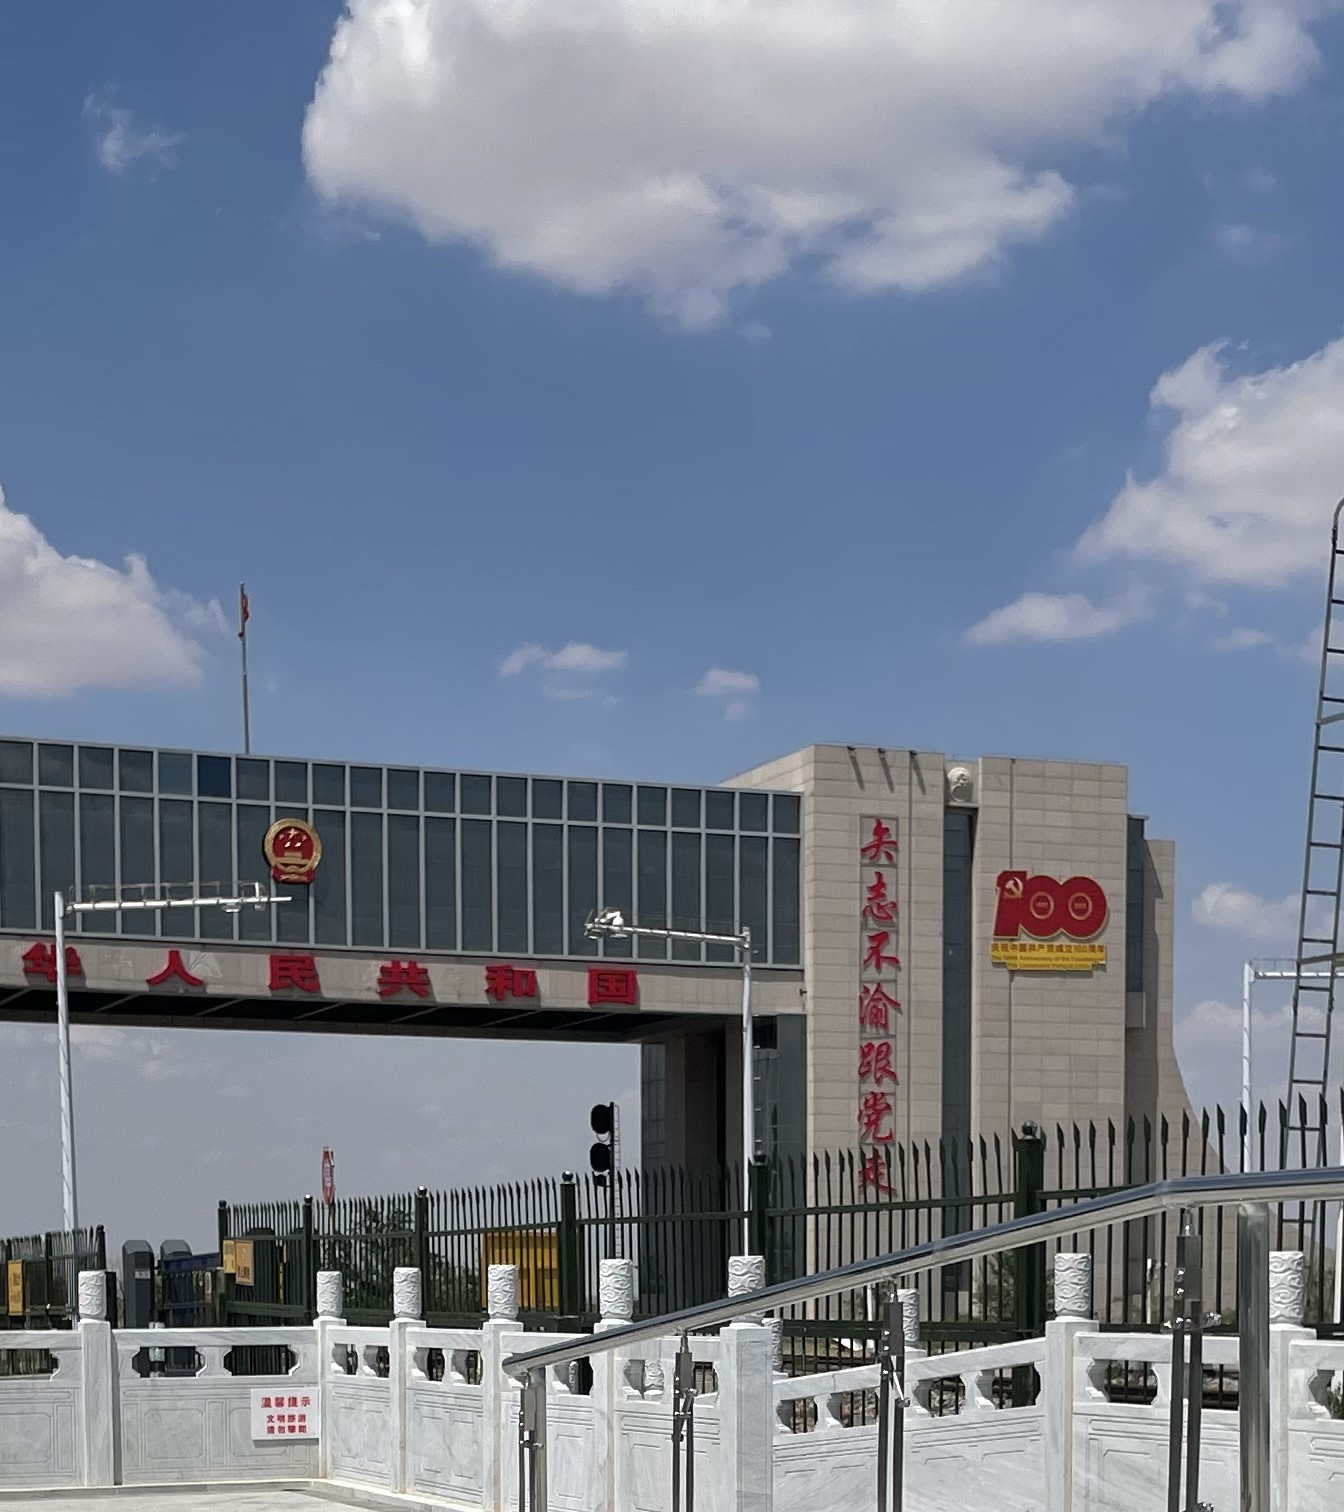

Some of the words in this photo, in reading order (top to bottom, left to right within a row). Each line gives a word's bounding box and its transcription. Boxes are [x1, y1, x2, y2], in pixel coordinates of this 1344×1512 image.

[857, 818, 902, 1196] 矢志不渝跟党走
[993, 870, 1107, 939] 100
